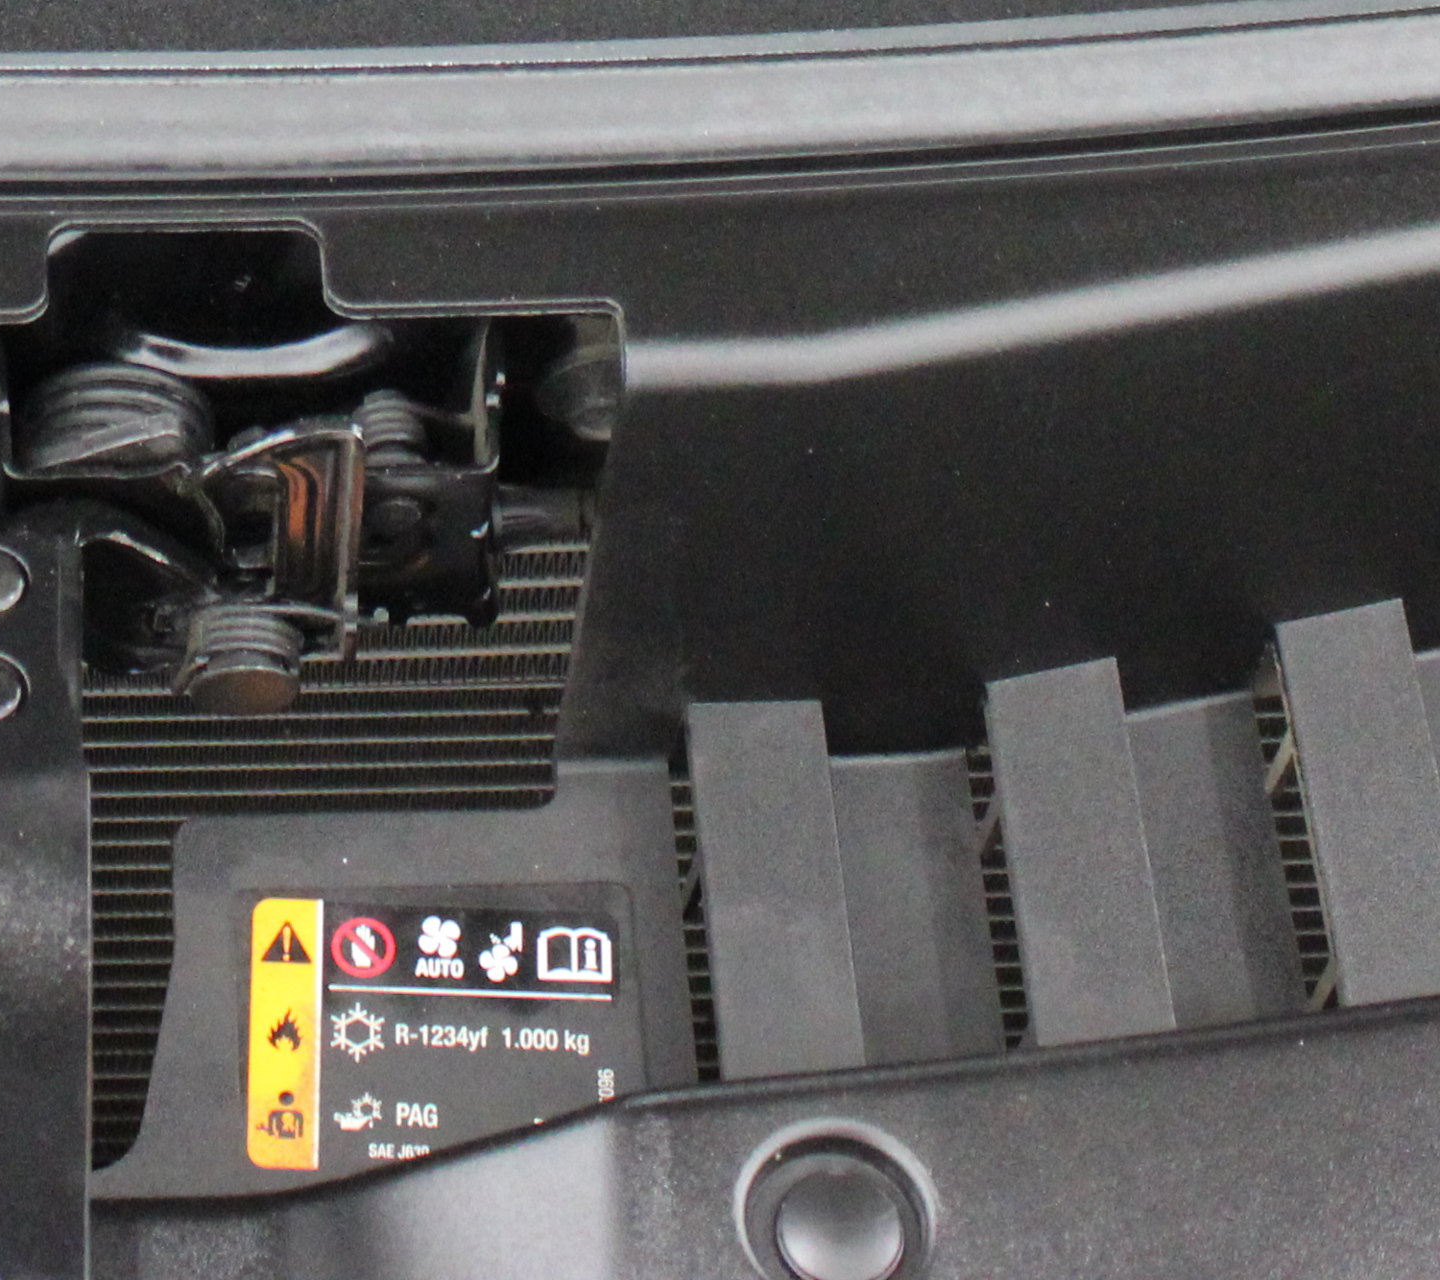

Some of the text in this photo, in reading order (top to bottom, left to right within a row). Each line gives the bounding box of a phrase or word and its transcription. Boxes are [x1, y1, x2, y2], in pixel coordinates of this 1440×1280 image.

[414, 957, 465, 979] AUTO
[394, 1023, 591, 1056] R-1234yf 1.000 kg
[395, 1102, 439, 1129] PAG
[368, 1142, 395, 1159] SAE
